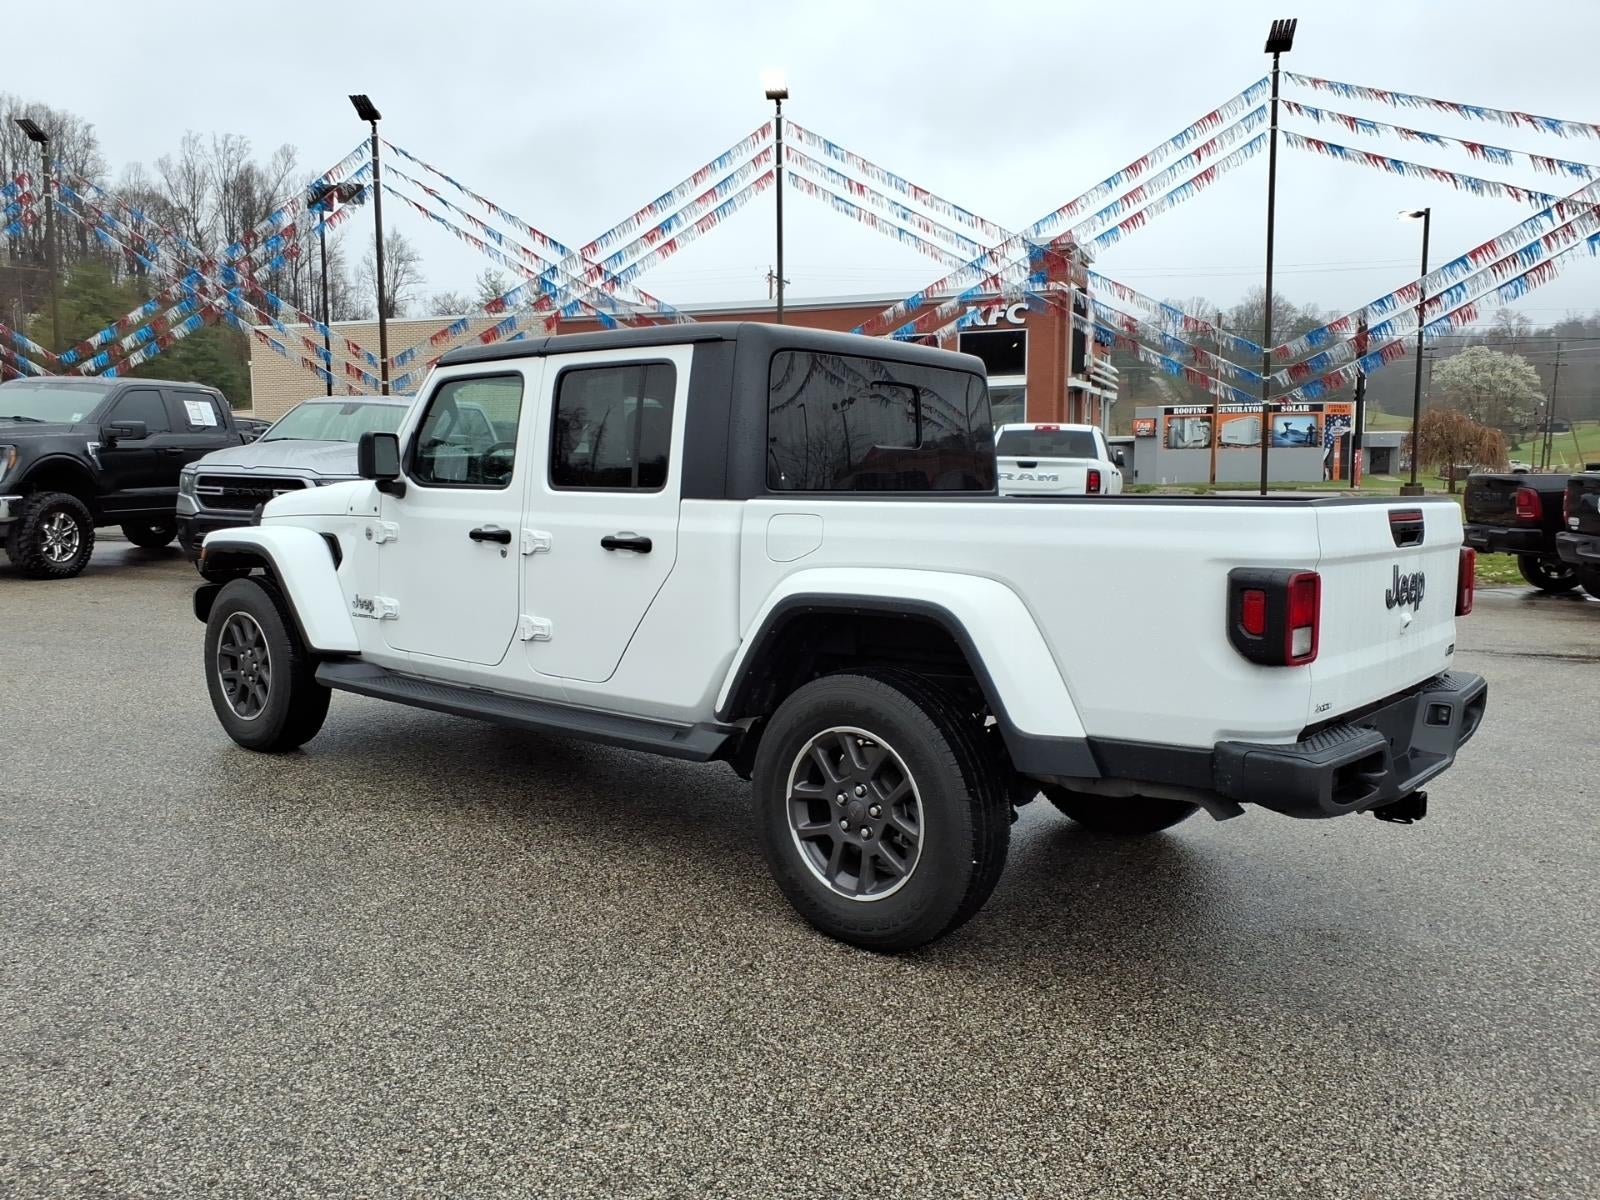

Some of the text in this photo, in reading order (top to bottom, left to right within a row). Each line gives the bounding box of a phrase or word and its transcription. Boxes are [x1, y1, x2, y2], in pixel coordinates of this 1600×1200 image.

[962, 303, 1029, 327] KFC
[1173, 407, 1207, 415] ROOFING
[1280, 404, 1310, 412] SOLAR
[998, 472, 1059, 482] RAM
[1385, 564, 1425, 612] Jeep
[352, 594, 375, 613] Jeep
